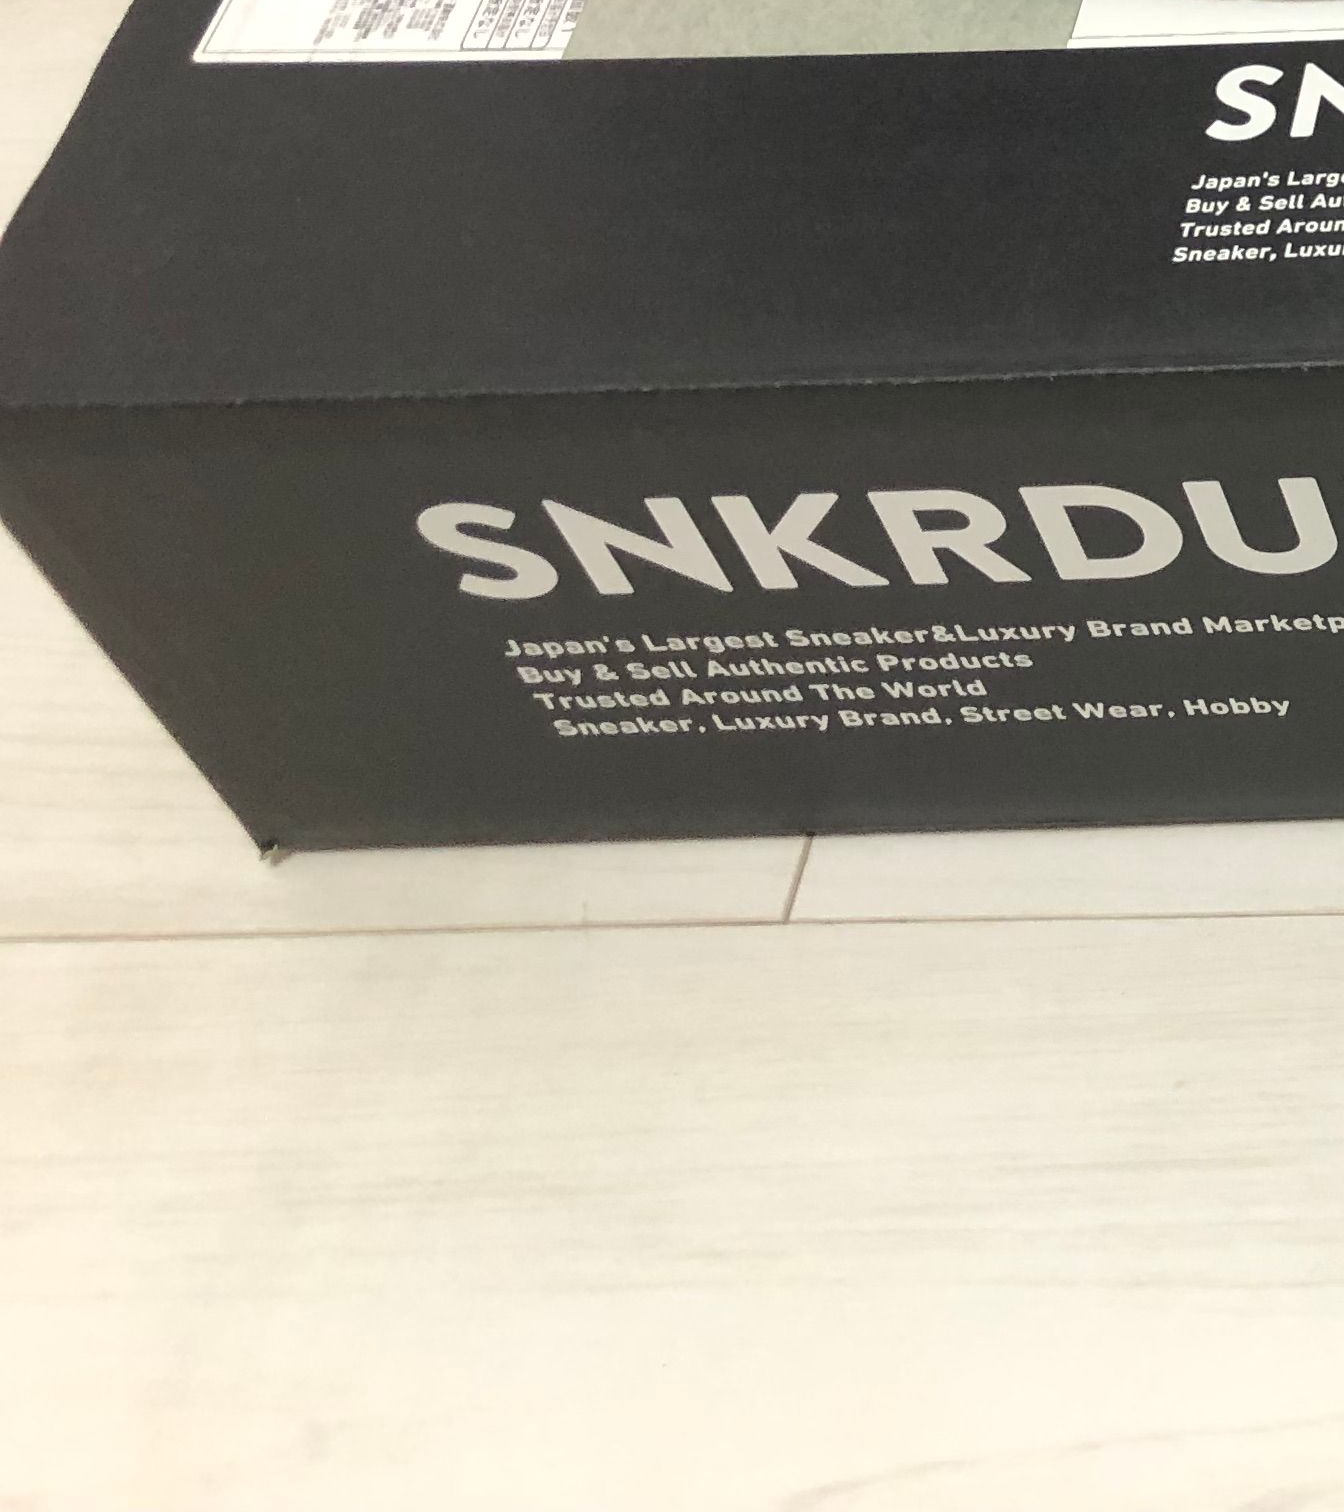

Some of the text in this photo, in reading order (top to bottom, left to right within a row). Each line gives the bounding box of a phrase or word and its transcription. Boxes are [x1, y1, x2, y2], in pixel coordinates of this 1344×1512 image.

[1190, 171, 1281, 193] Japan's
[1185, 198, 1230, 216] Buy
[1235, 195, 1251, 212] &
[1258, 193, 1305, 211] Sell
[1180, 218, 1271, 238] Trusted
[1171, 244, 1277, 263] Sneaker,
[504, 635, 636, 659] Japan's
[641, 631, 779, 654] Largest
[784, 624, 1076, 647] Sneaker&Luxury
[1086, 617, 1194, 638] Brand
[516, 651, 1034, 686] Buy & Sell Authentic Products
[532, 679, 988, 710] Trusted Around The World
[553, 697, 1290, 737] Sneaker, Luxury Brand, Street Wear, Hobby
